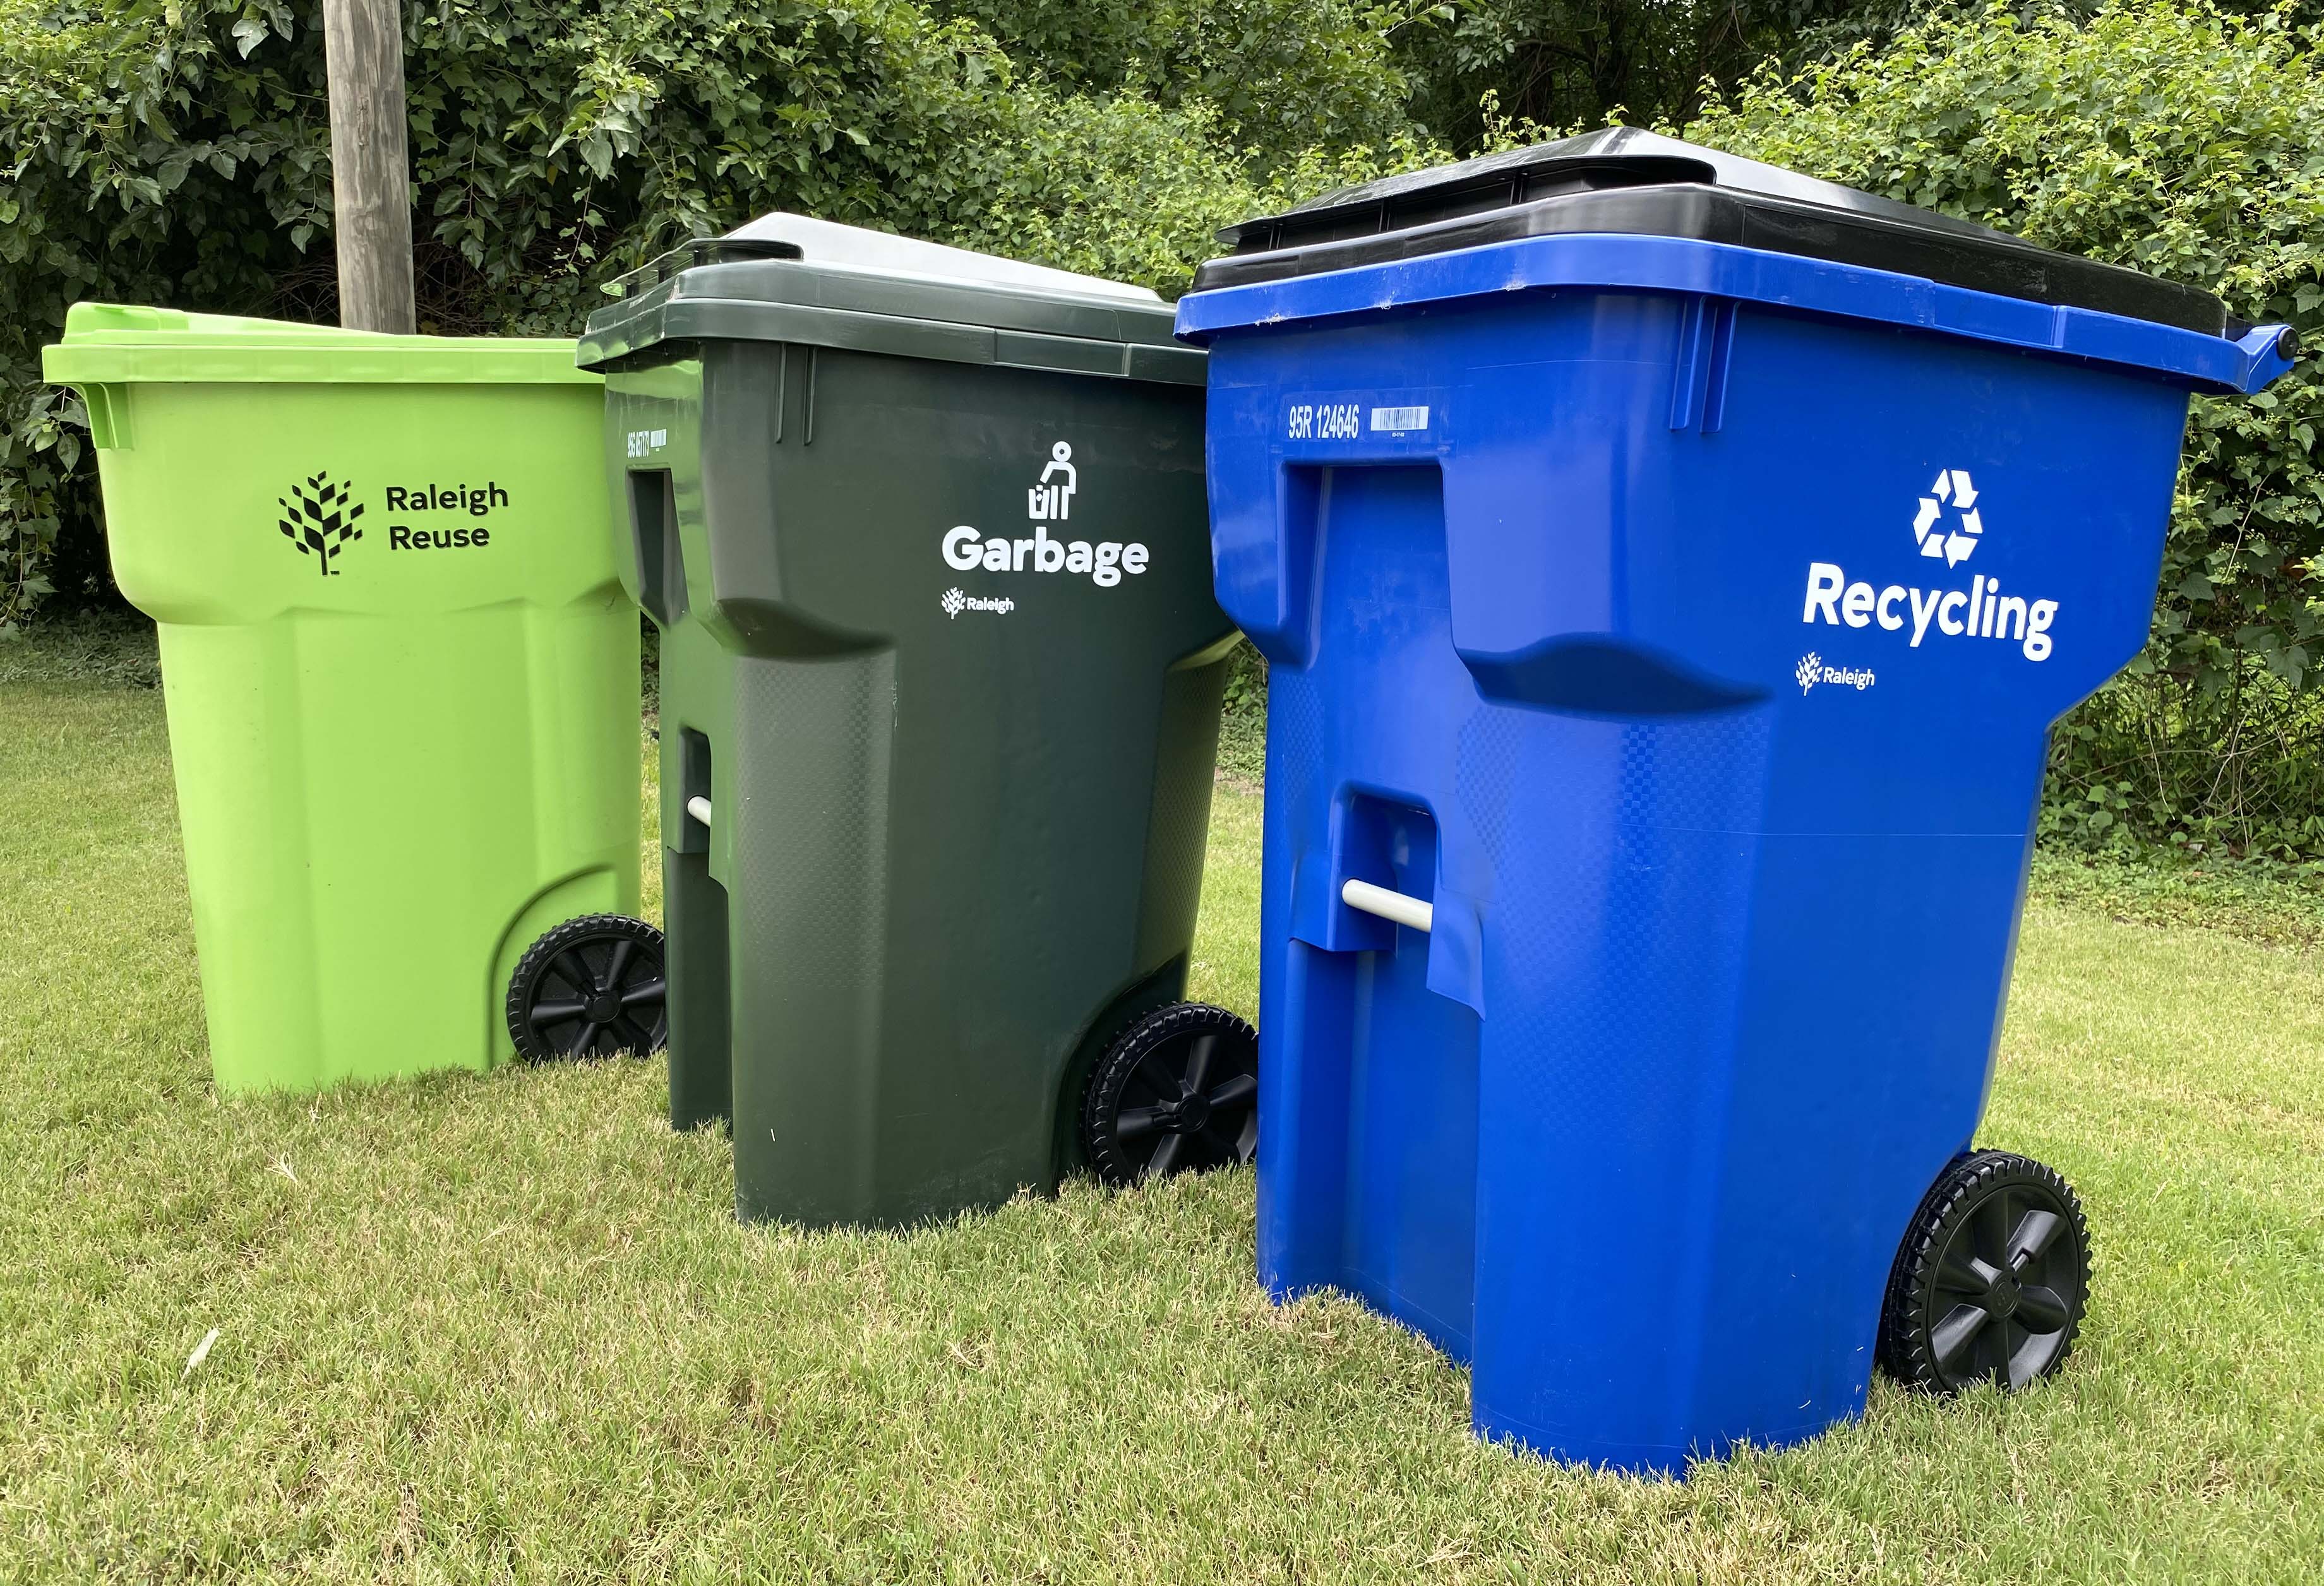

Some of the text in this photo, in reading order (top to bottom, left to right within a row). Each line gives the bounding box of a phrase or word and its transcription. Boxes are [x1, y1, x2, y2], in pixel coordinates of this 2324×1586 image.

[1288, 403, 1360, 439] 95R 124646
[386, 481, 509, 516] Raleigh
[389, 525, 490, 551] Reuse
[942, 525, 1149, 587] Garbage
[966, 597, 1014, 614] Raleigh
[1802, 562, 2059, 662] Recycling
[1823, 666, 1875, 691] Raleigh
